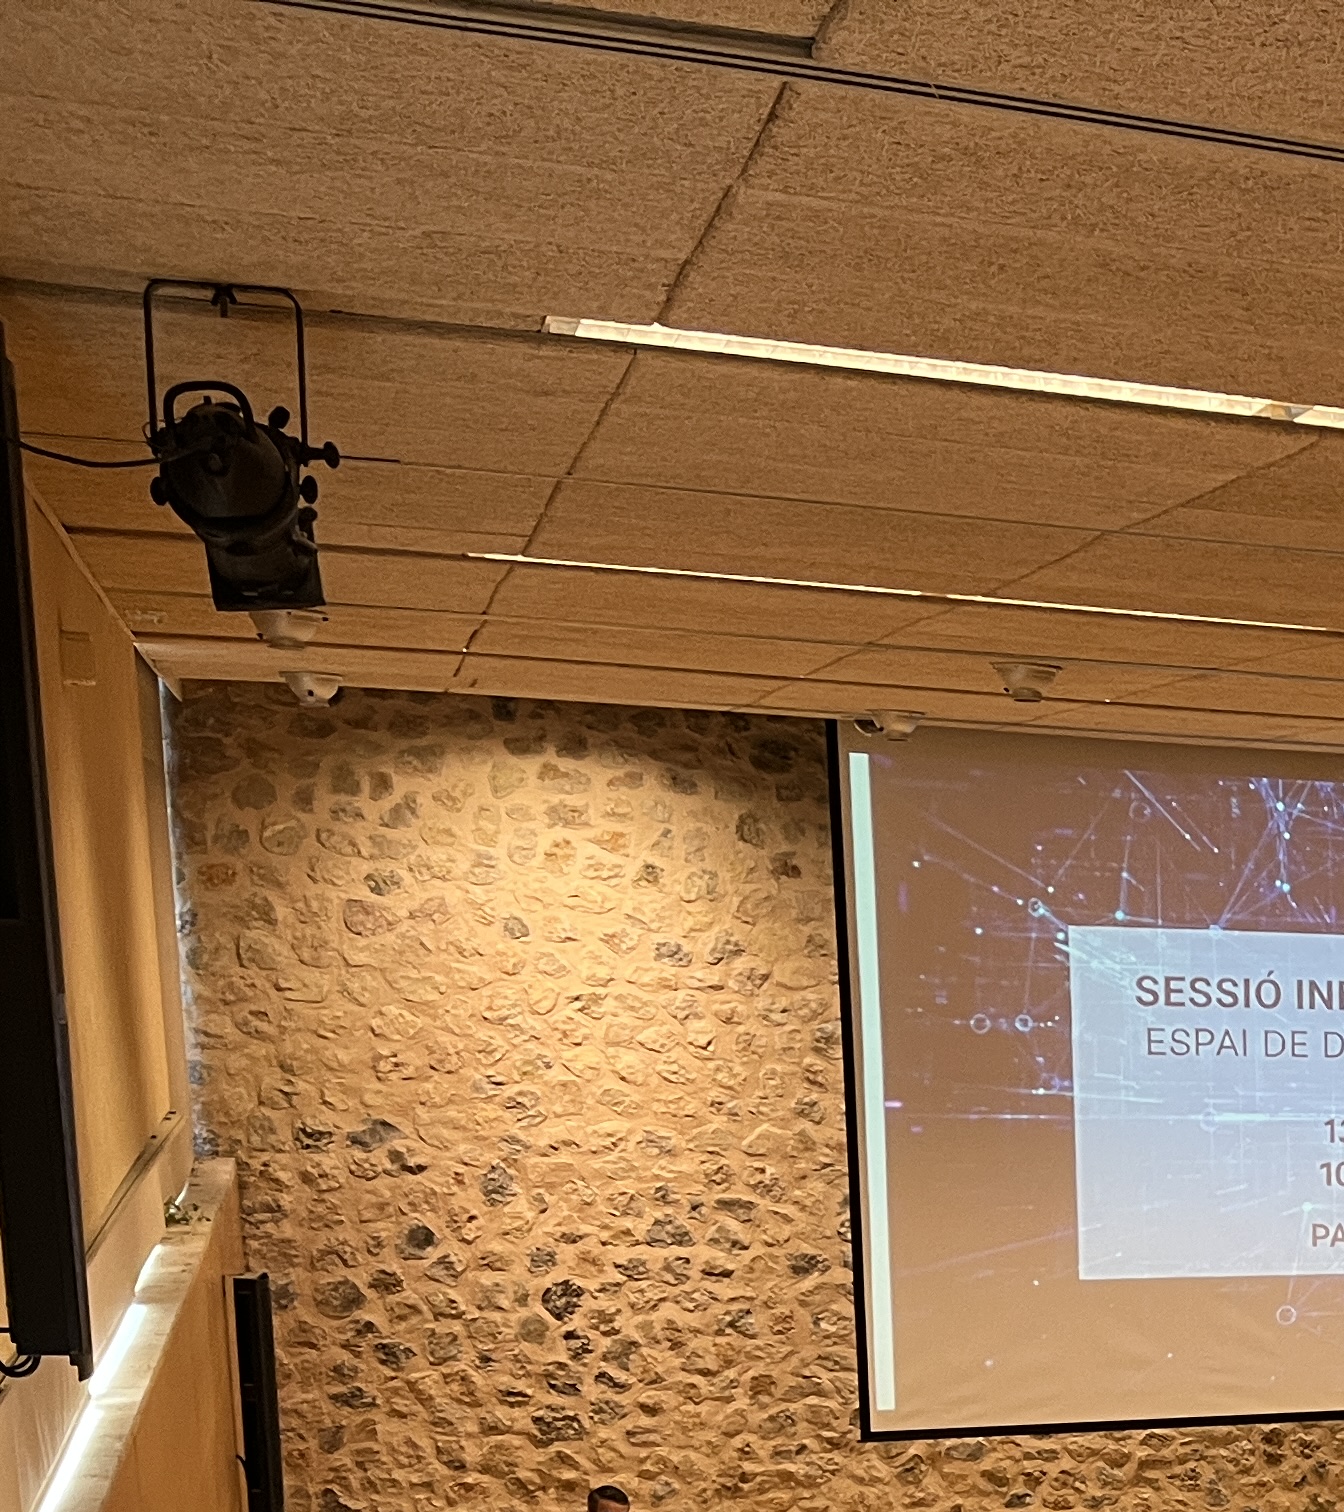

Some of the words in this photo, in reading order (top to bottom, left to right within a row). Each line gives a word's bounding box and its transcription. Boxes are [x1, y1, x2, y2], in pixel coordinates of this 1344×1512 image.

[1135, 970, 1281, 1009] SESSIÓ
[1147, 1027, 1248, 1056] ESPAI
[1264, 1029, 1309, 1058] DE
